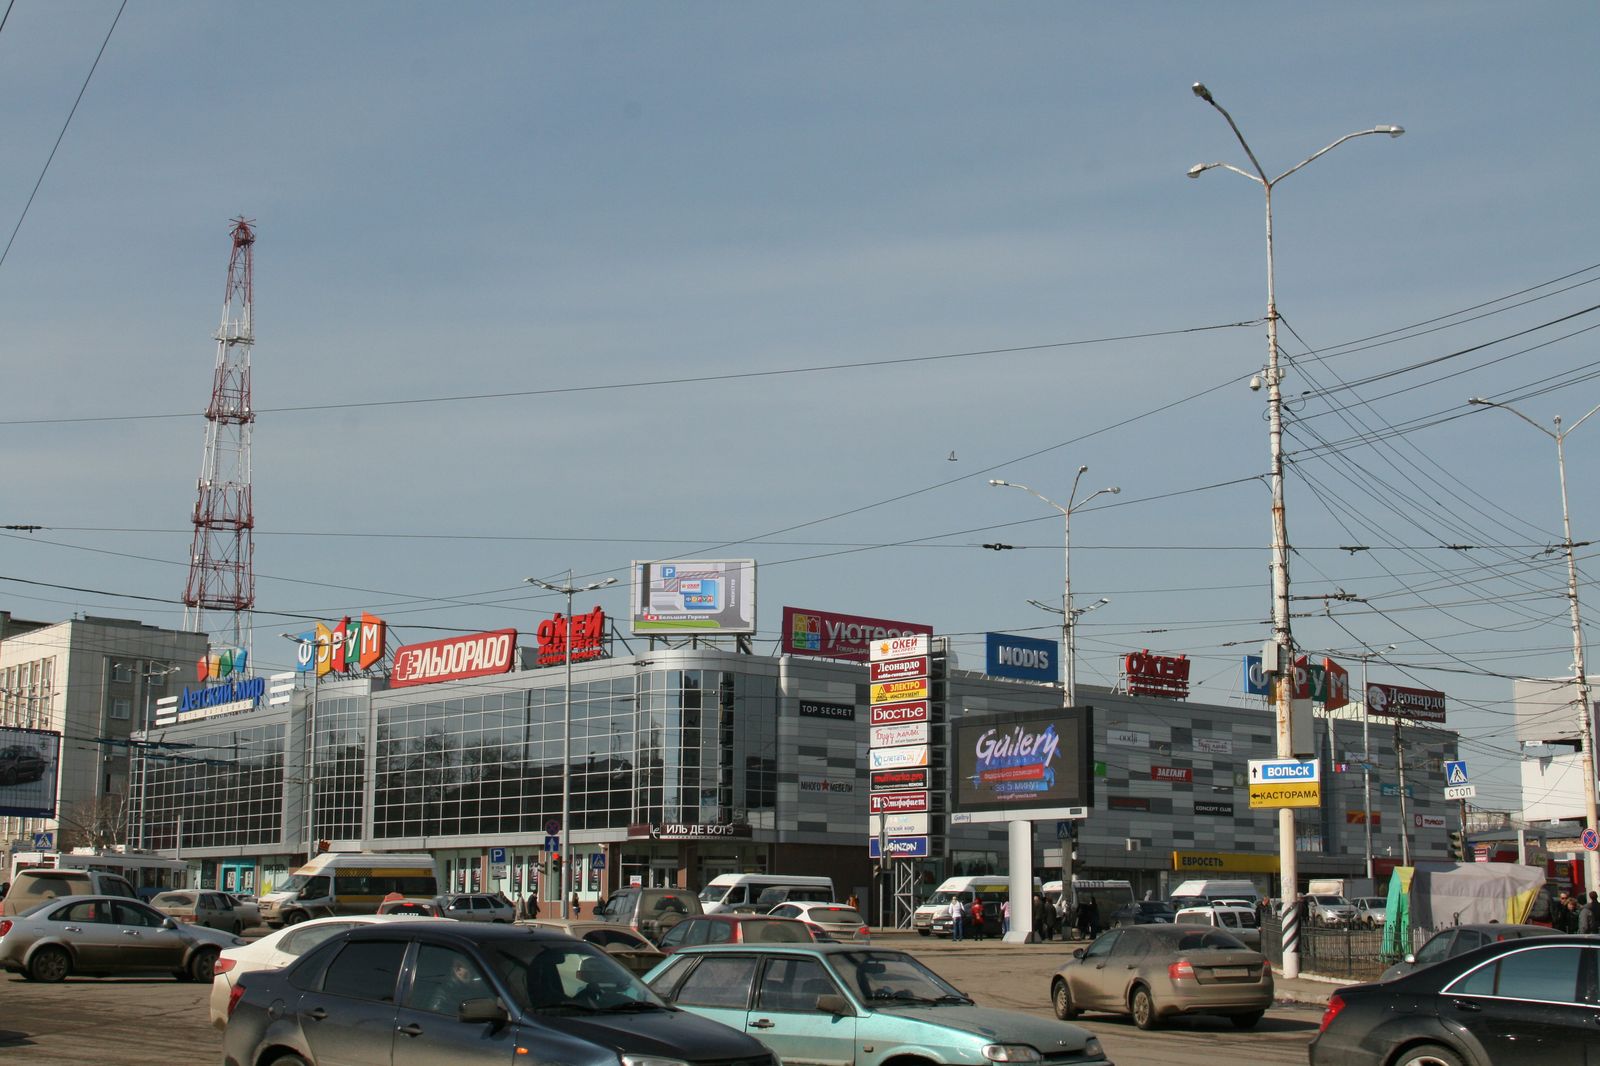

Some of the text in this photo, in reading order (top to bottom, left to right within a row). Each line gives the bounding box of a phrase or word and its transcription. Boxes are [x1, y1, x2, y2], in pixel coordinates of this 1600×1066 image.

[298, 623, 379, 666] ФОРУМ
[999, 645, 1049, 670] MODIS
[877, 660, 920, 673] Леонардо
[889, 680, 920, 692] ЭЛЕКТРО
[1249, 660, 1350, 702] ФРУМ
[179, 676, 265, 713] Детский мир
[1387, 687, 1445, 709] Леонардо
[801, 705, 852, 717] TOP SECRET
[873, 706, 924, 721] Бюстье
[1267, 766, 1310, 777] ВОЛЬСК
[801, 781, 853, 794] МНОГО МЕБЕЛИ
[1449, 786, 1473, 797] СТОП
[1260, 790, 1318, 800] КАСТОРАМА
[1195, 804, 1219, 812] CONCEPT
[666, 824, 688, 834] ИЛЬ
[689, 824, 705, 836] ДЕ
[706, 823, 734, 835] БОТЭ
[1182, 856, 1224, 867] ЕВРОСЕТЬ
